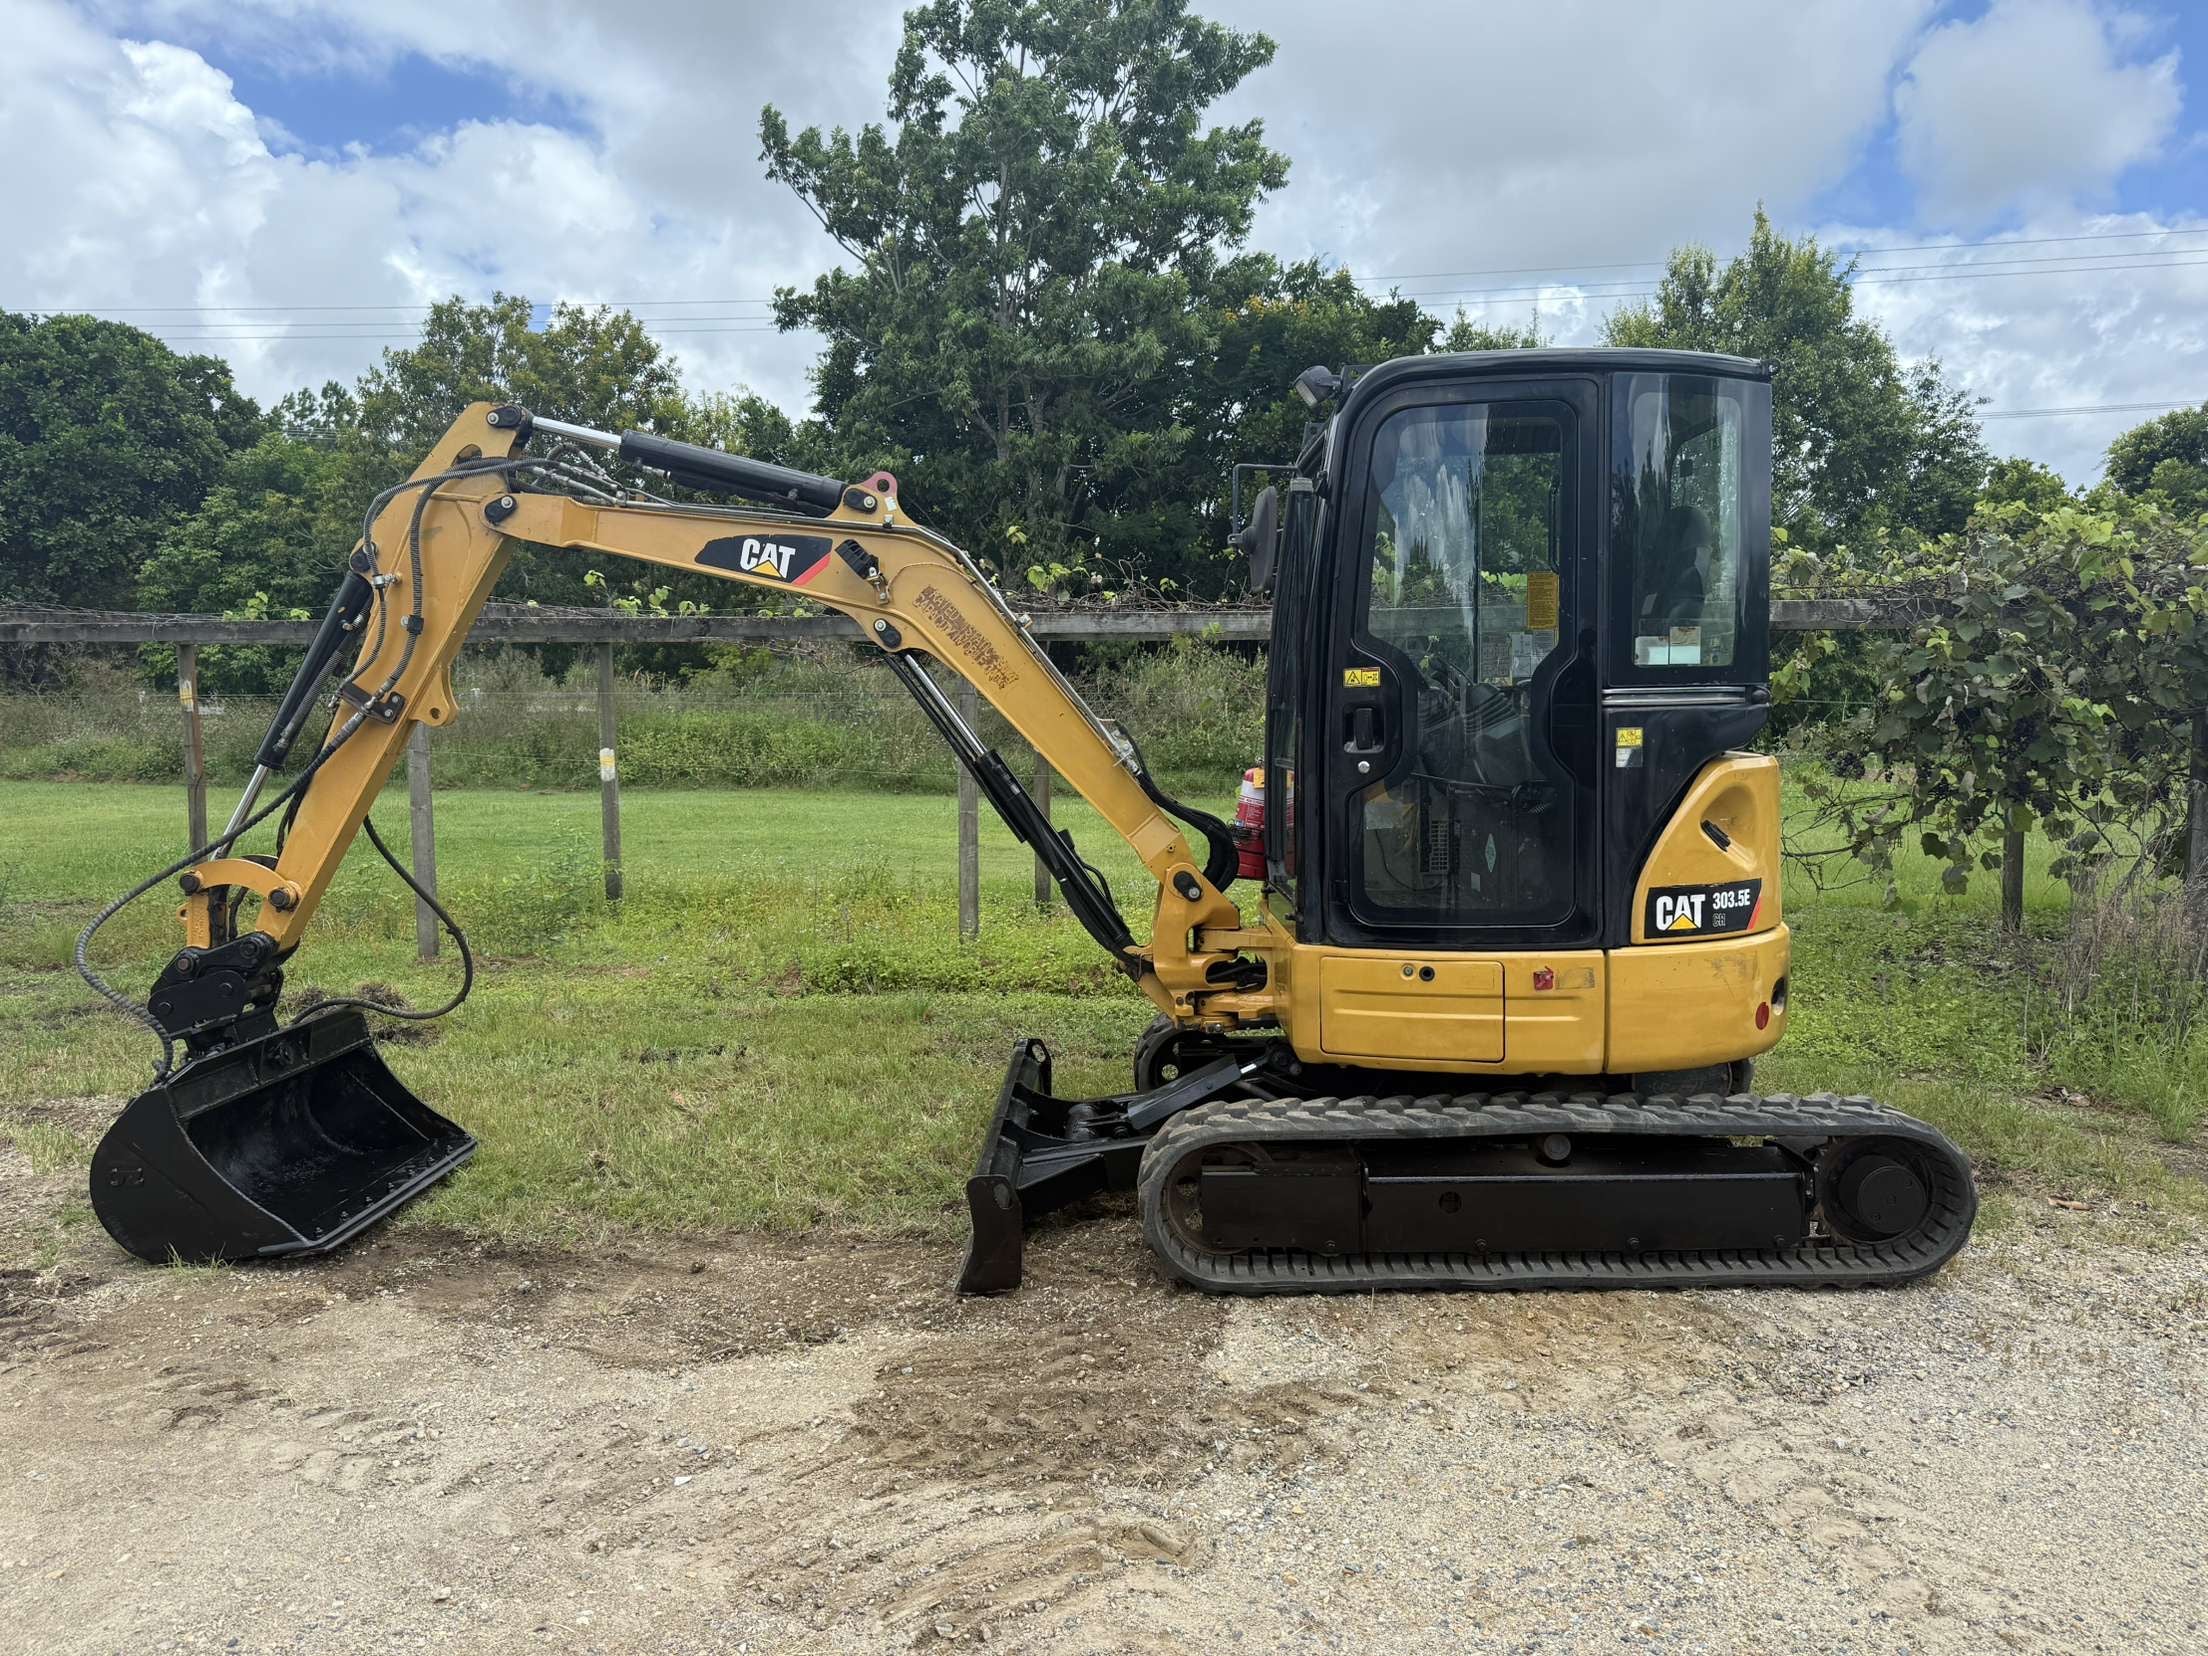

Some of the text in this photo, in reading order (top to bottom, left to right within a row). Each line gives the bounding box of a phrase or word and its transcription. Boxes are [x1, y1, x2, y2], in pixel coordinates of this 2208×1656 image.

[740, 538, 796, 579] CAT
[1656, 888, 1750, 931] CAT 303.5E
